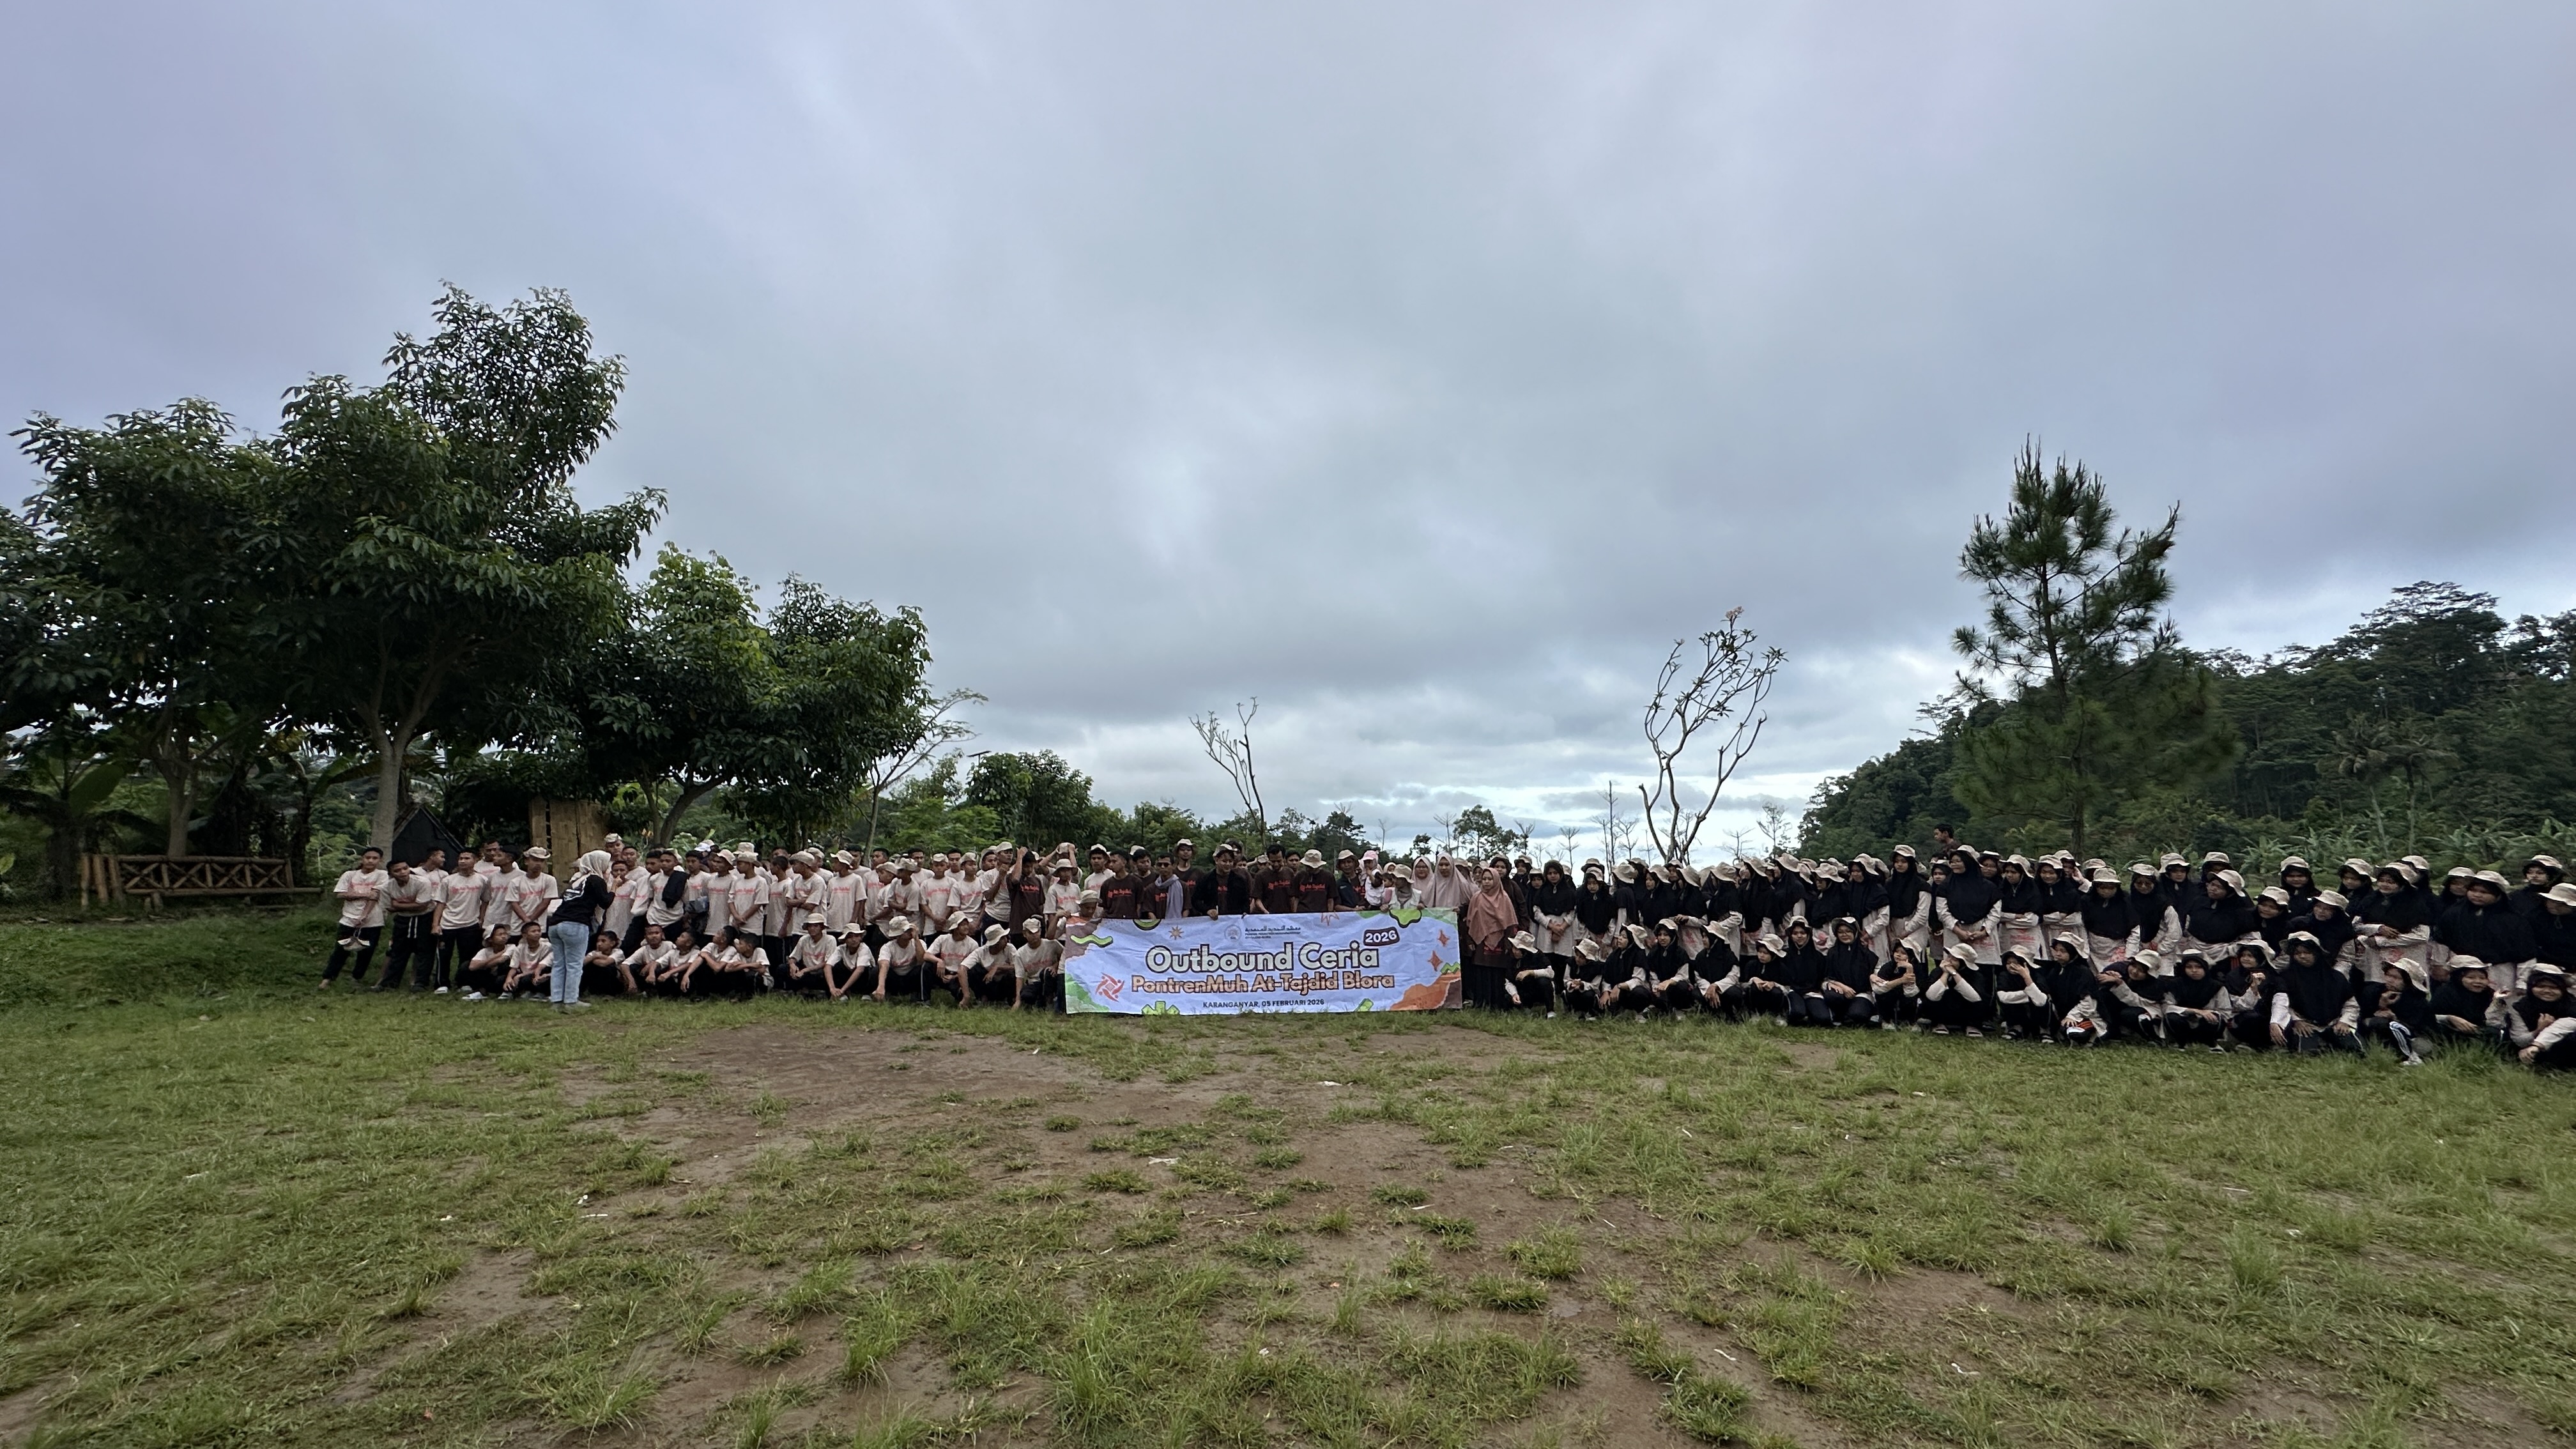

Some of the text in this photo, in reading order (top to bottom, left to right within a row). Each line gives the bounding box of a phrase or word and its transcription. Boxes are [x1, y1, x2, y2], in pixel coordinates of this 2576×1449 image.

[1365, 930, 1397, 943] 2026
[1146, 940, 1379, 973] Outbound Ceria
[1131, 970, 1395, 996] PontrenMuh At-Tajdid Blora
[1202, 1000, 1261, 1009] KARANGANYAR,
